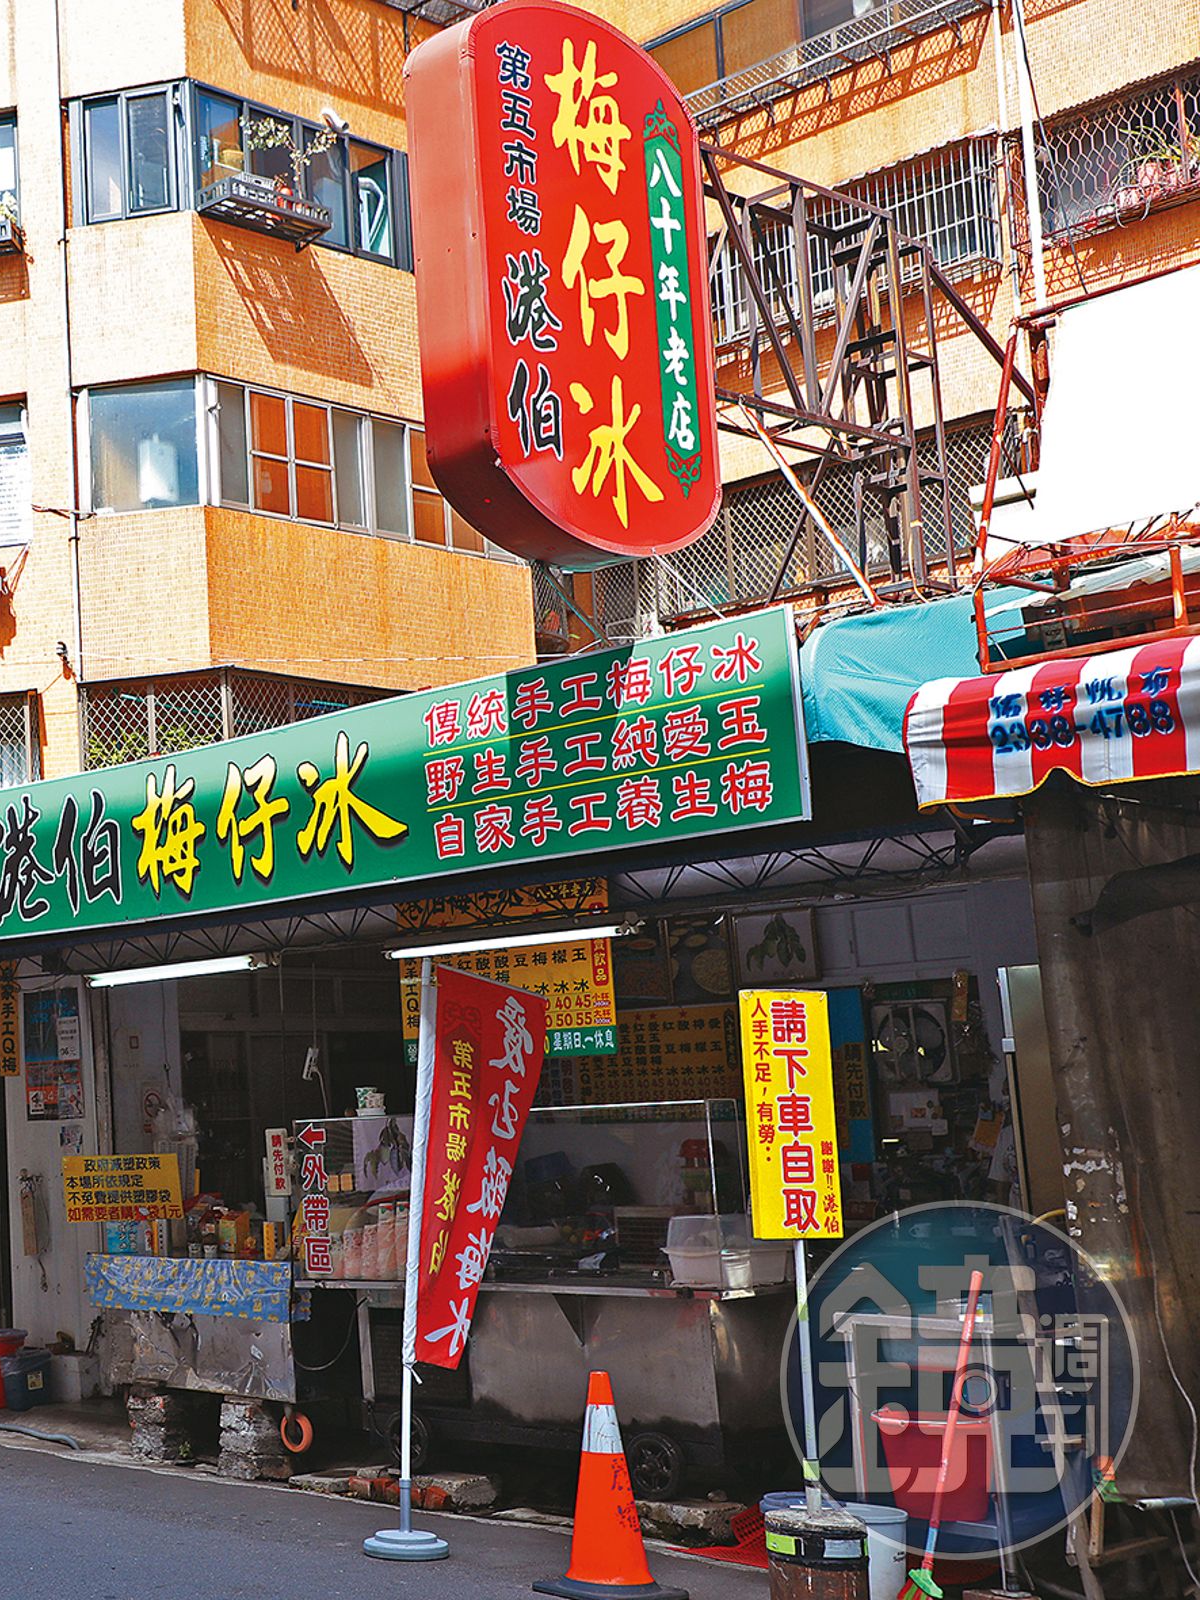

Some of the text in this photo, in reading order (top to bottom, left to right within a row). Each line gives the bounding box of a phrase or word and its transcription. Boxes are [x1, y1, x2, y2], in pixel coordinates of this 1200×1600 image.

[495, 40, 565, 461] 第五市場 港伯
[543, 37, 665, 530] 梅仔冰
[649, 148, 697, 452] 八十年老店
[422, 631, 763, 747] 傳統手工梅仔冰
[425, 695, 767, 805] 野生手工純愛玉
[432, 759, 773, 860] 自家手工養生梅
[84, 1157, 161, 1172] 政府減塑政策
[271, 1135, 287, 1190] 請先付款
[771, 1000, 820, 1232] 請下車自取
[66, 1174, 143, 1189] 本場所依規定
[302, 1153, 332, 1274] 外帶區
